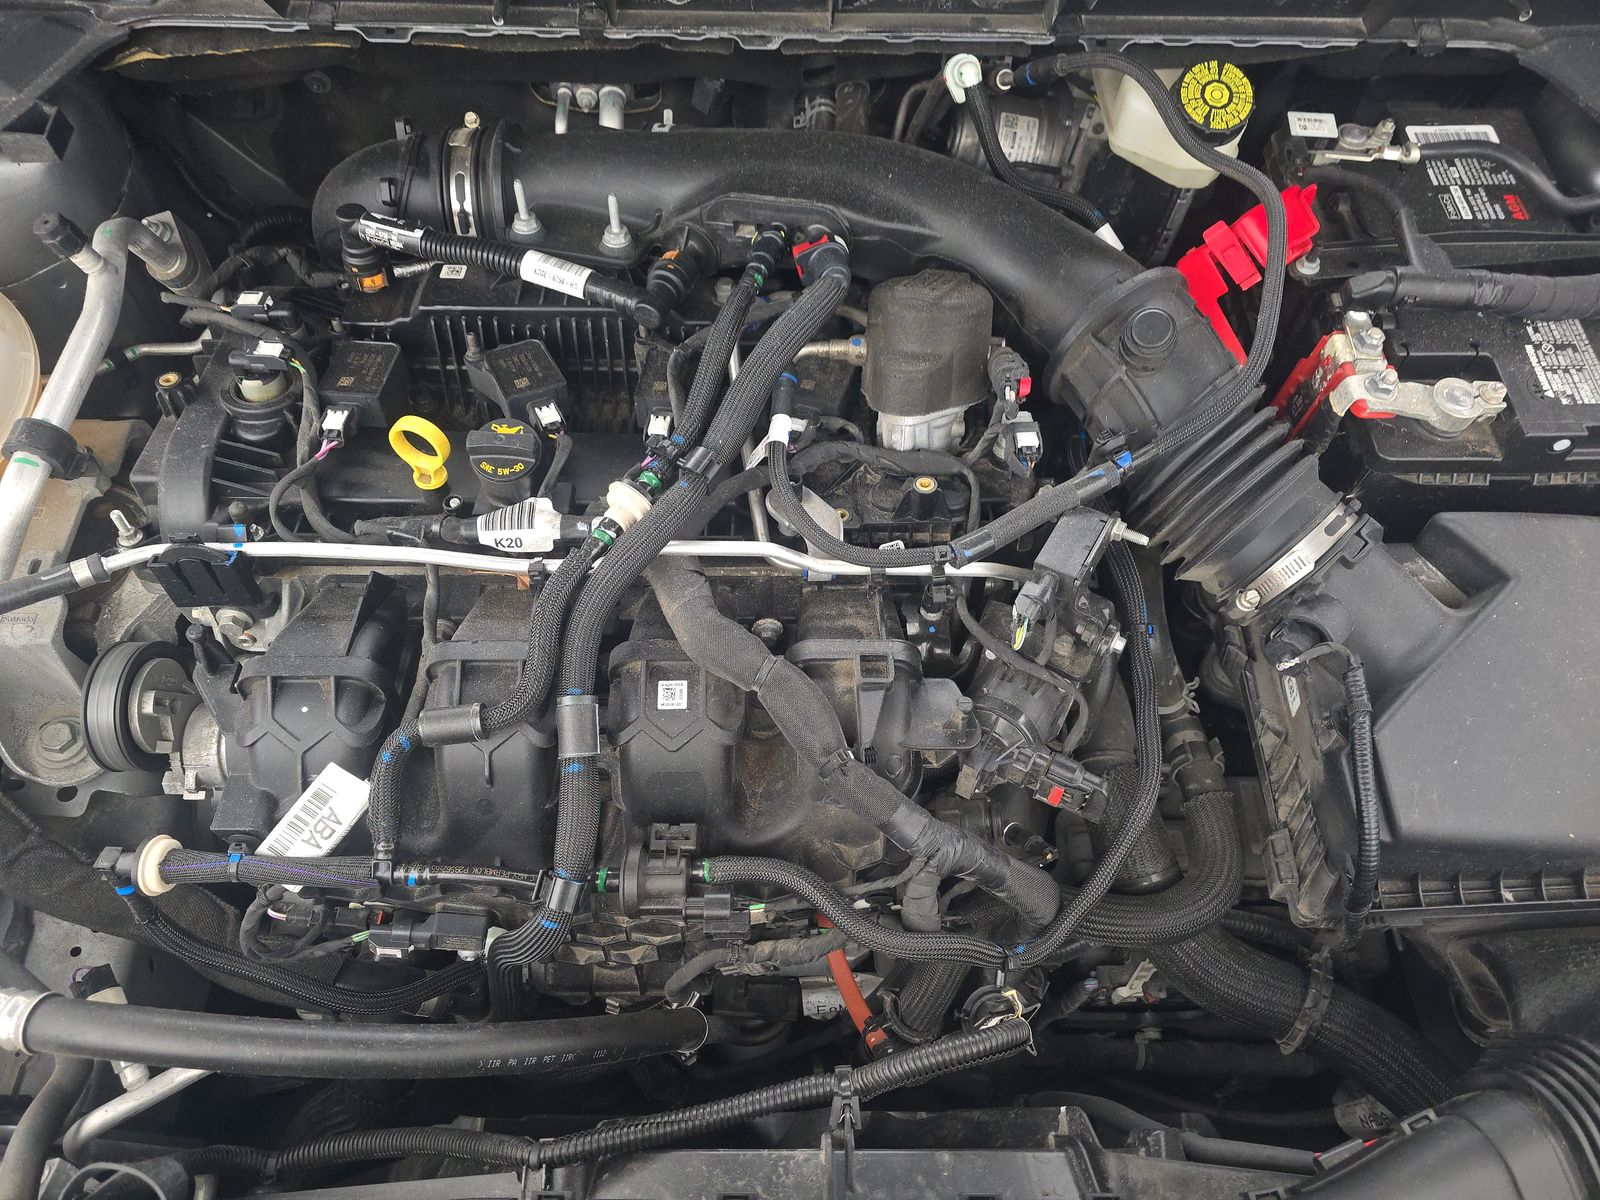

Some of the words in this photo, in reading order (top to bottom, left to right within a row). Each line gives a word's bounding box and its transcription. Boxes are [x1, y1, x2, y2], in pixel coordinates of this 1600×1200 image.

[480, 461, 495, 474] SAE
[497, 462, 525, 475] 5W-30
[494, 537, 523, 548] K20
[301, 806, 343, 850] ABA
